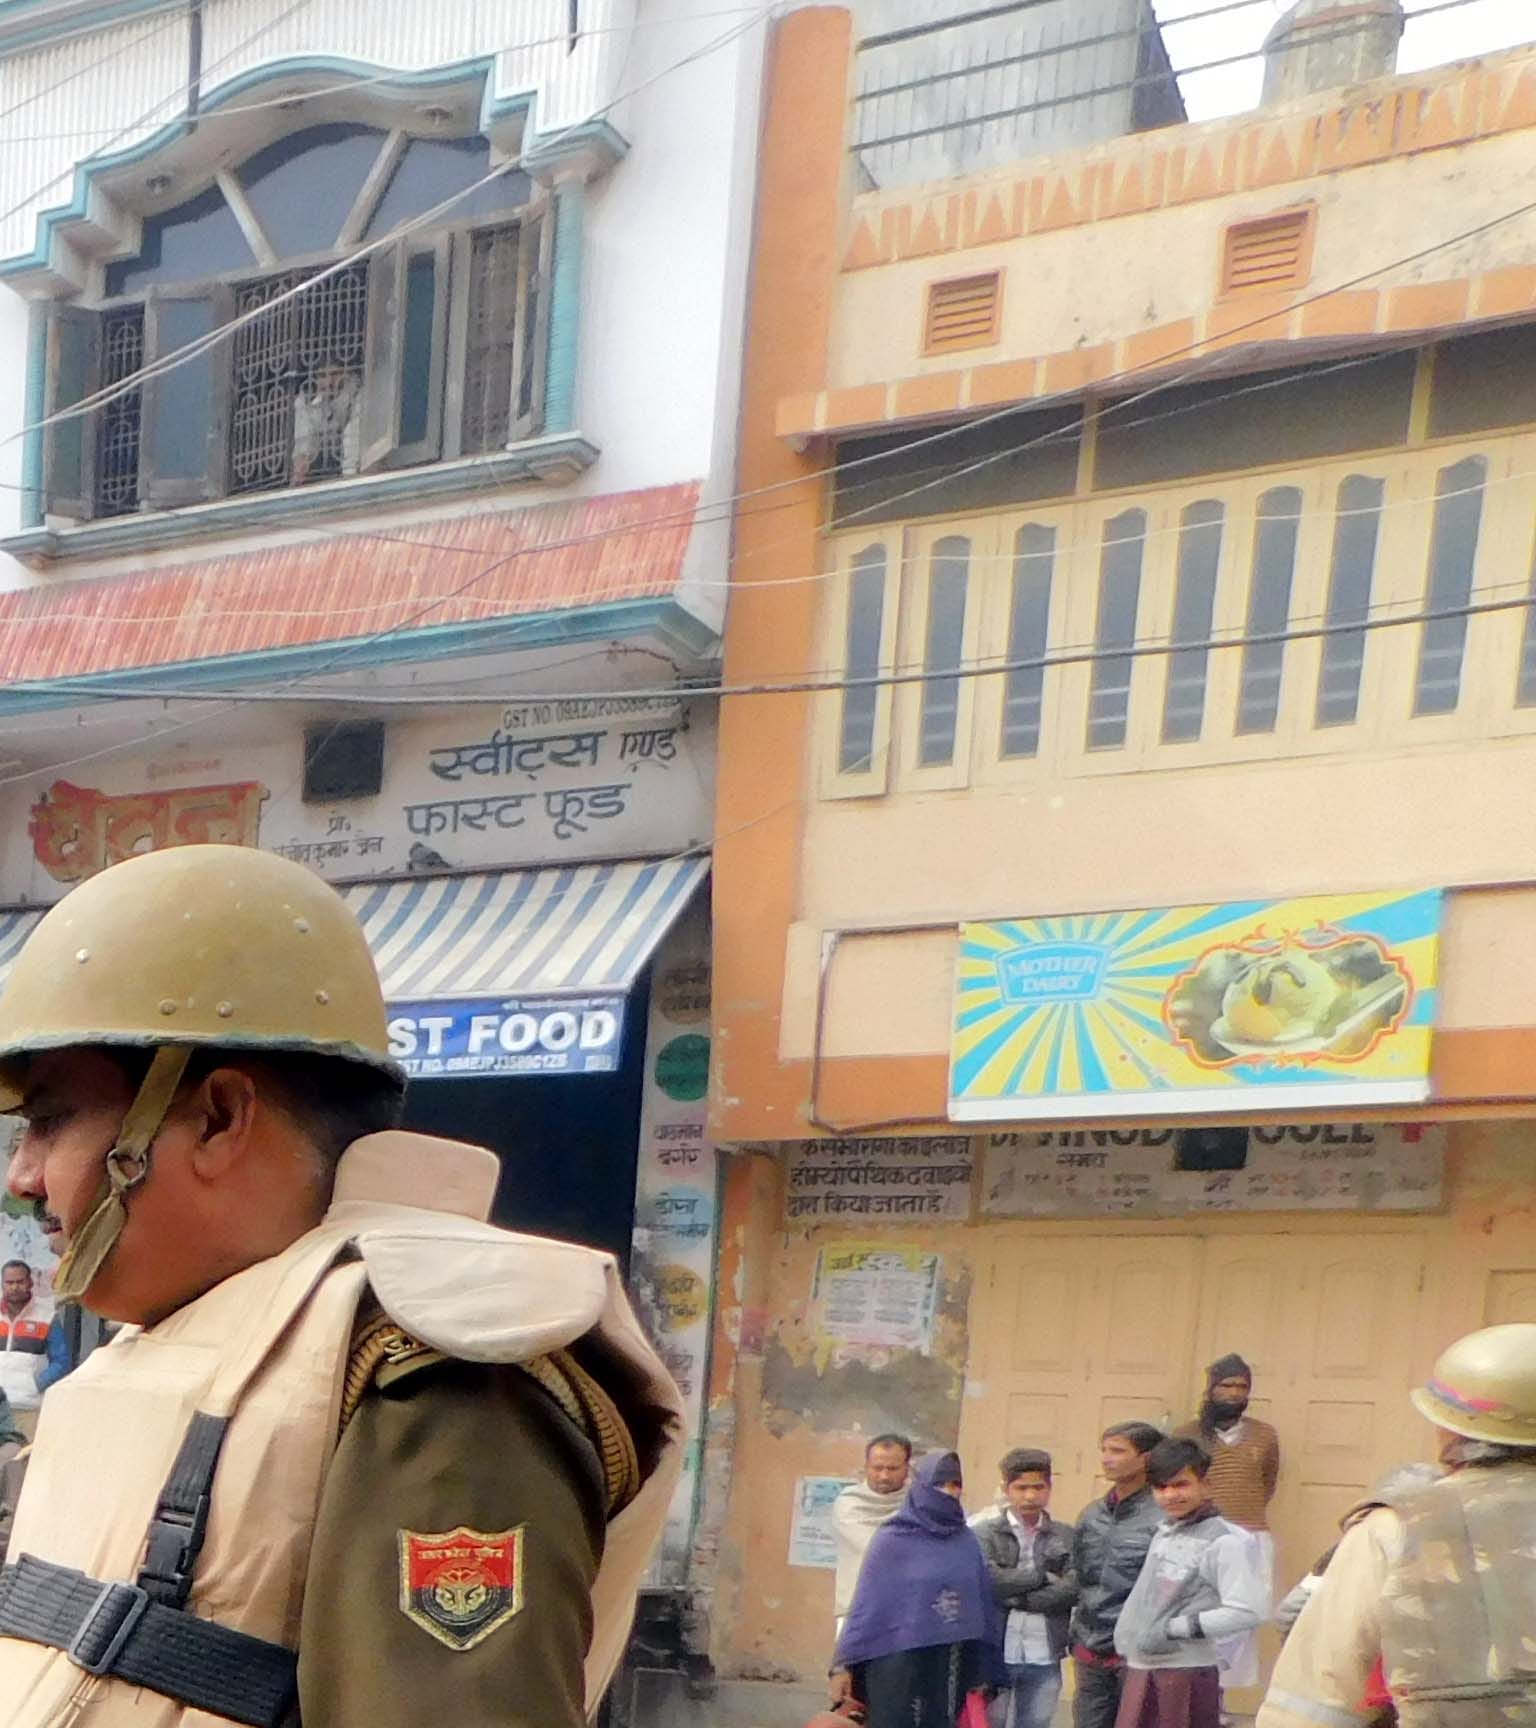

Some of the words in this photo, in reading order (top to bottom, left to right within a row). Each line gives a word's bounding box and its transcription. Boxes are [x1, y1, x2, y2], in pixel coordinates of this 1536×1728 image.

[403, 793, 536, 835] फास्ट
[543, 783, 632, 839] फूड
[1008, 956, 1096, 976] MOTHER
[1023, 975, 1083, 992] DAIRY
[467, 1010, 617, 1053] FOOD
